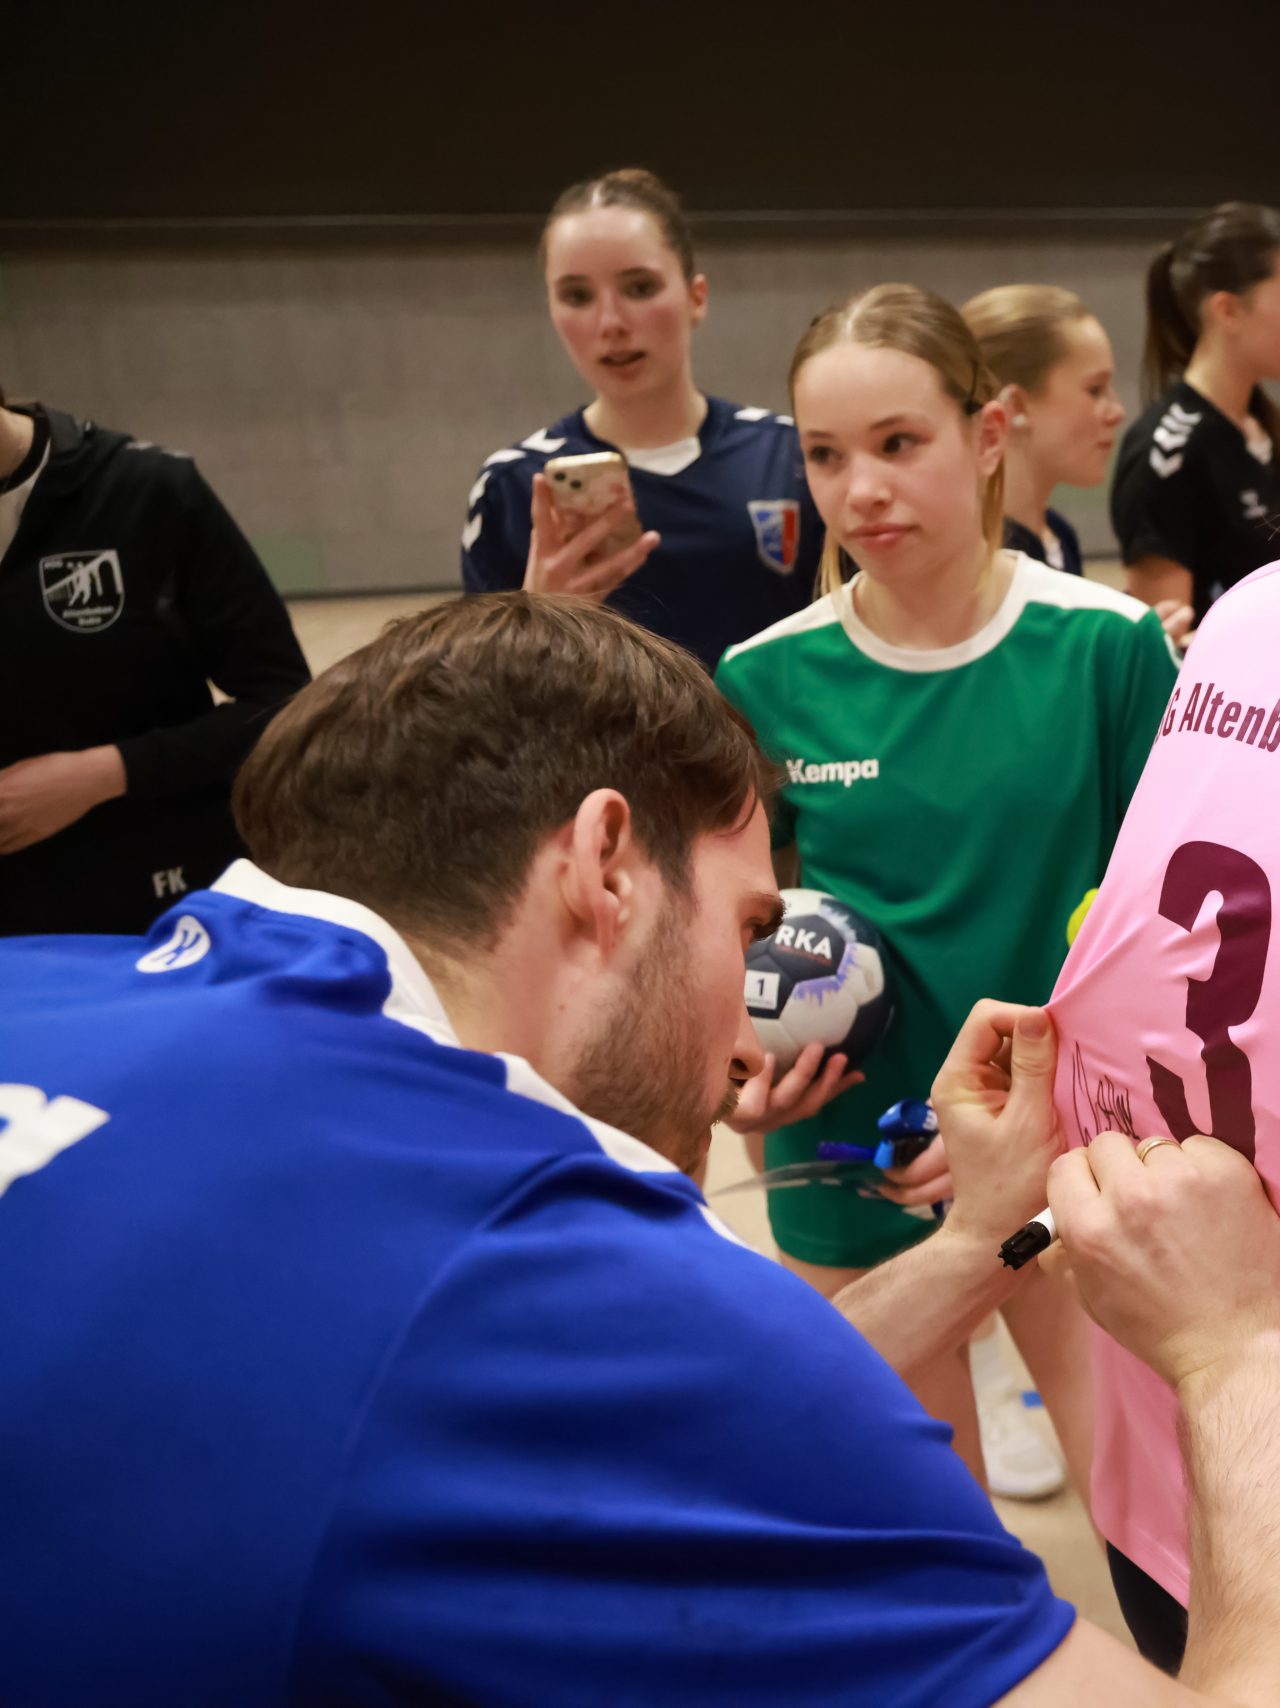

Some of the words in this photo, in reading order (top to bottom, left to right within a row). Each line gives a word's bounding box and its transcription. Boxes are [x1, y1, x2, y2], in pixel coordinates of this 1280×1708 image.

[785, 757, 880, 788] Kempa
[152, 866, 188, 898] FK
[774, 924, 833, 960] RKA
[756, 977, 766, 997] 1
[1146, 840, 1272, 1167] 3
